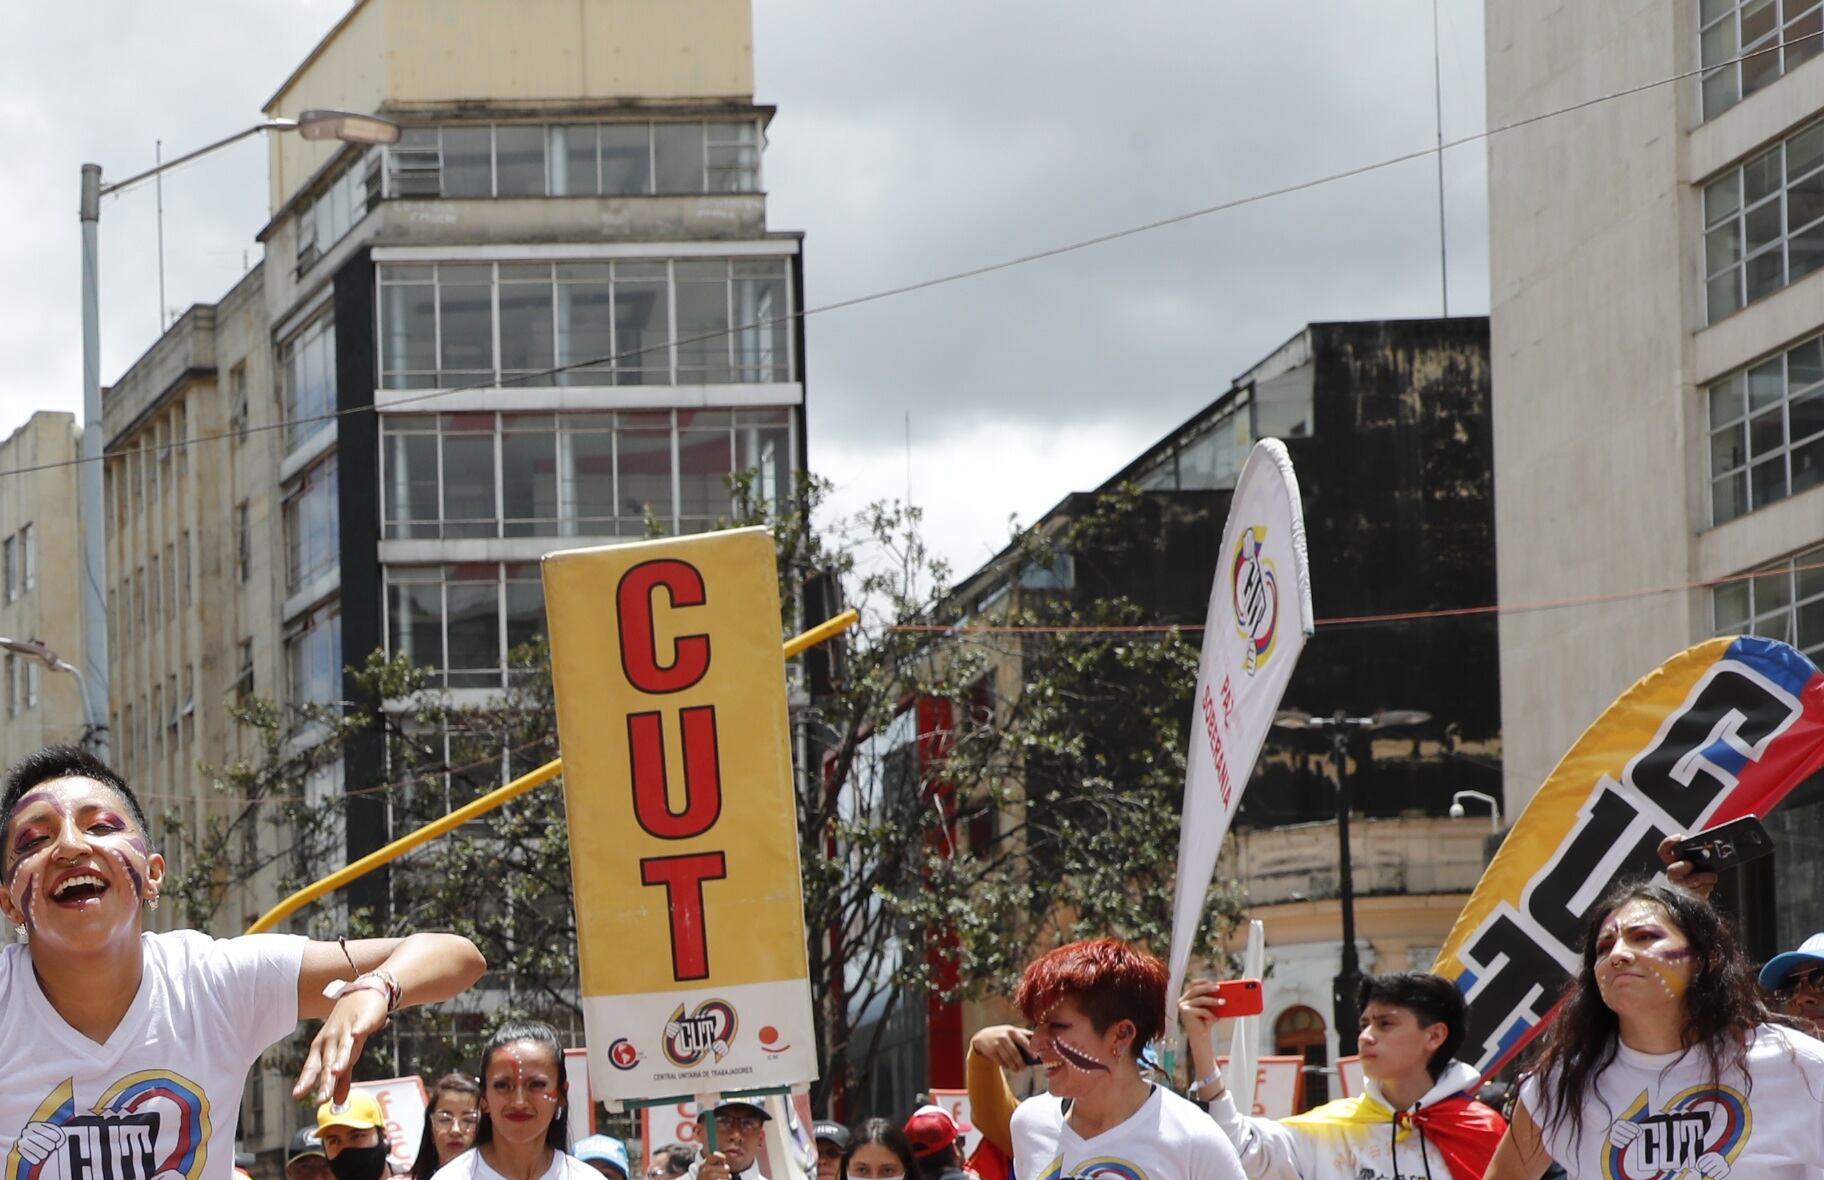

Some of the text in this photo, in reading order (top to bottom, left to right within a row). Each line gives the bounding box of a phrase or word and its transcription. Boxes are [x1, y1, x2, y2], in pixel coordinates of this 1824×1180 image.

[615, 558, 727, 982] CUT
[1202, 684, 1232, 812] SOBERANIA
[1460, 663, 1800, 1071] CUT
[653, 1066, 753, 1081] CENTRAL UNITARIA DE TRABAJADORES
[679, 1017, 716, 1050] CUT
[1637, 1114, 1708, 1172] CUT
